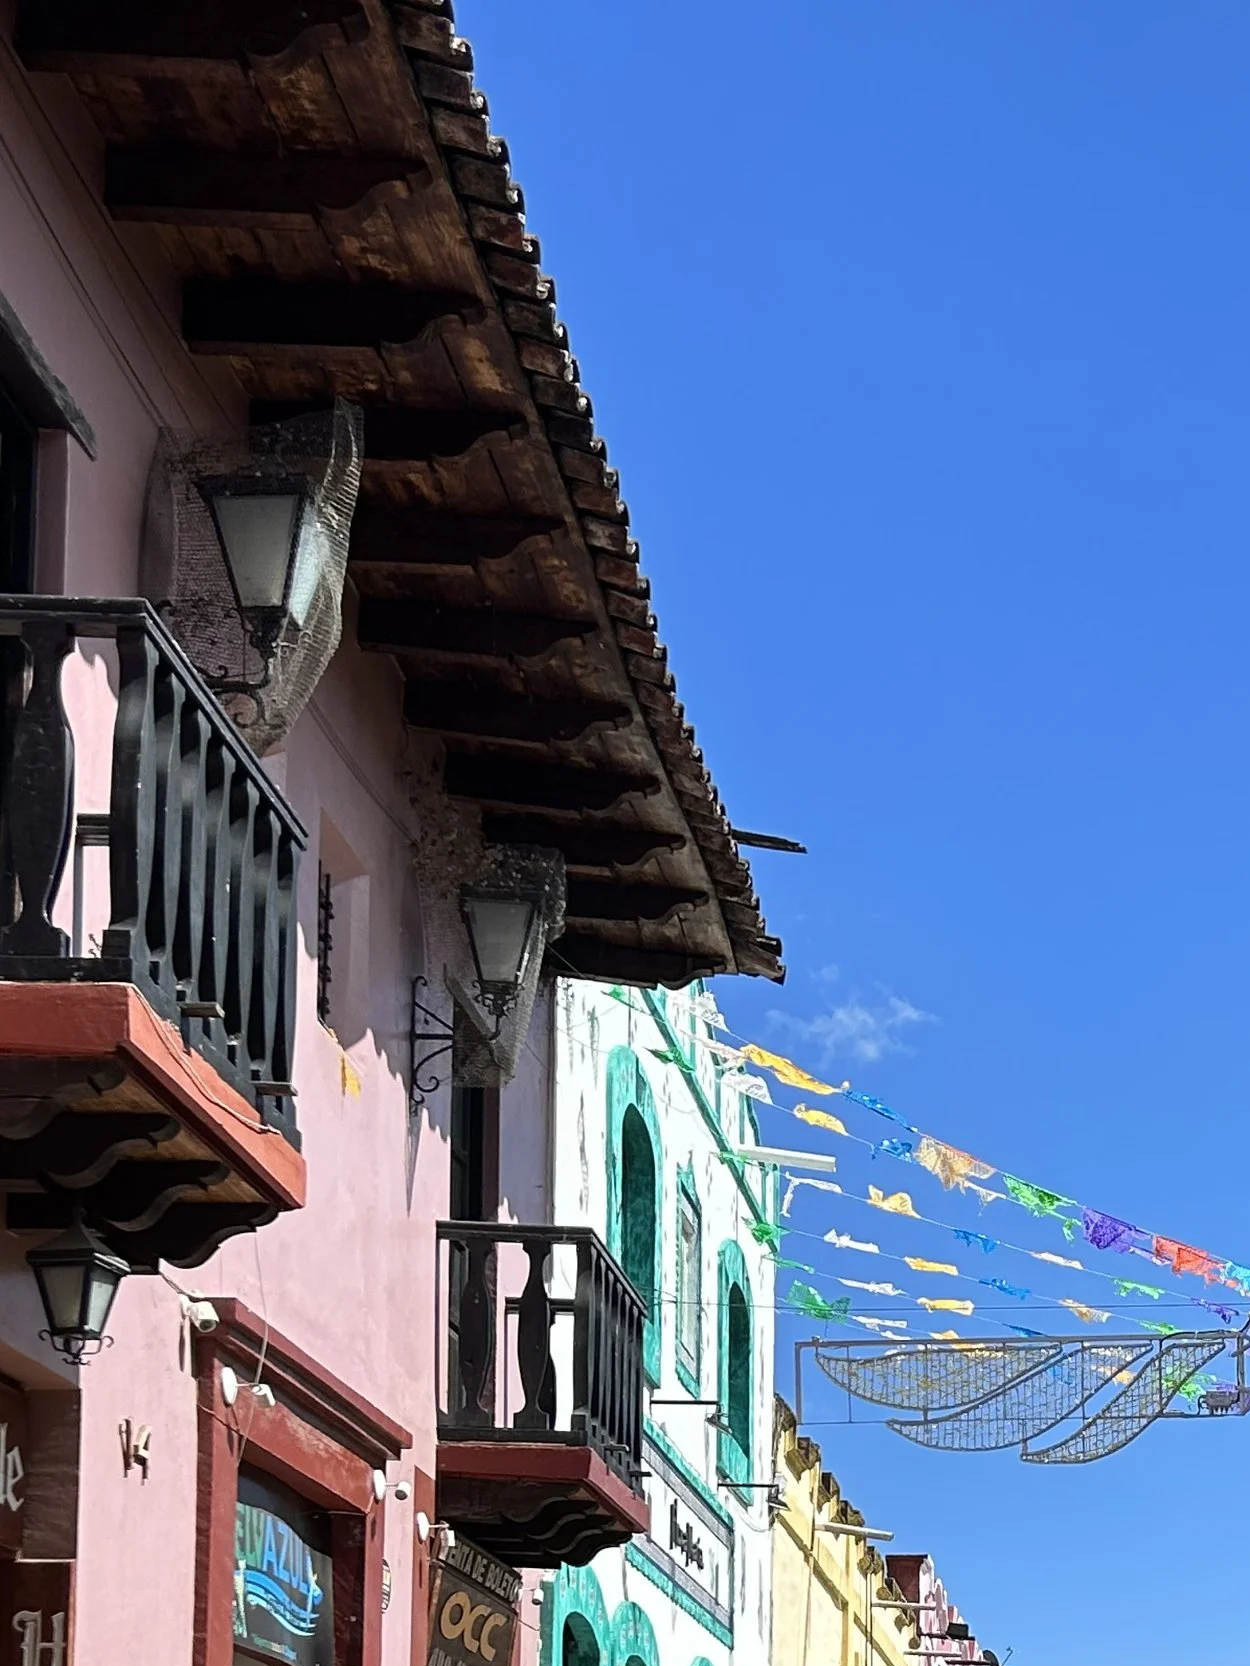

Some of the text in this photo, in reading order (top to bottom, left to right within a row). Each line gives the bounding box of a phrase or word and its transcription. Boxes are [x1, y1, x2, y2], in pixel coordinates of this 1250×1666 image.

[472, 1556, 488, 1584] DE
[485, 1563, 521, 1603] BOLETO
[440, 1591, 507, 1662] OCC
